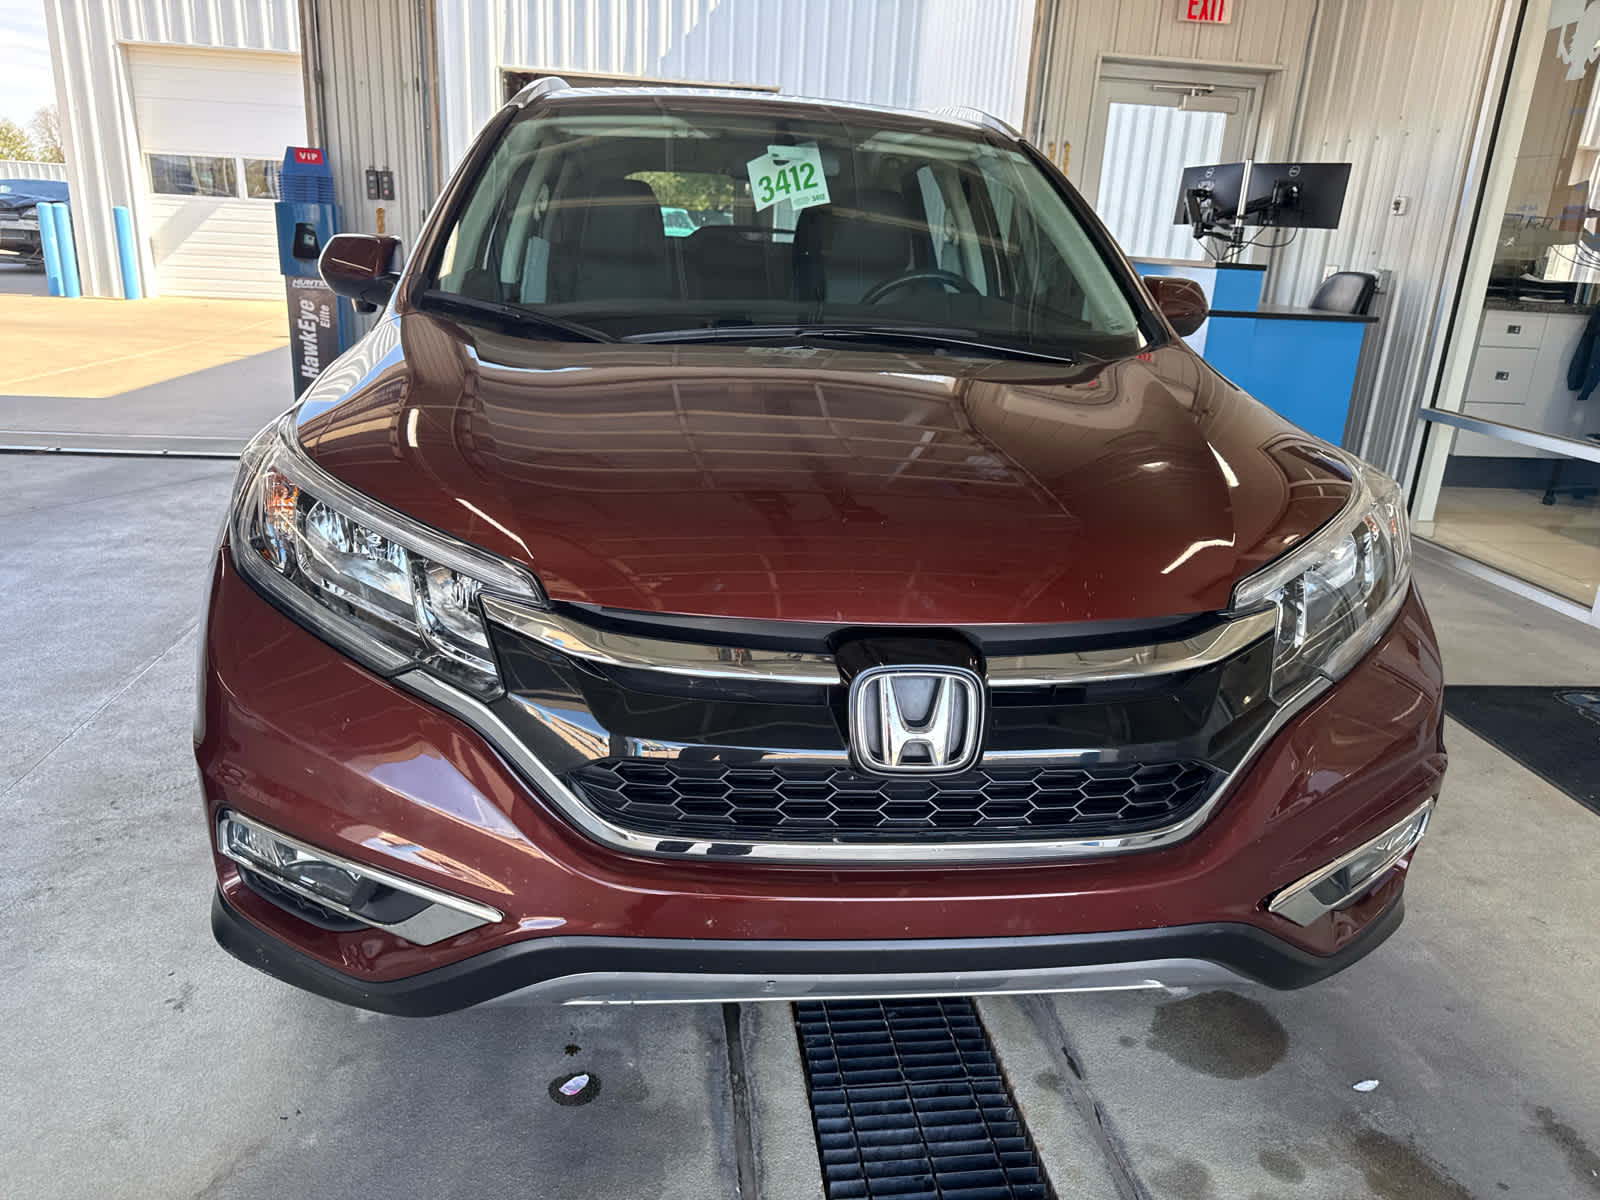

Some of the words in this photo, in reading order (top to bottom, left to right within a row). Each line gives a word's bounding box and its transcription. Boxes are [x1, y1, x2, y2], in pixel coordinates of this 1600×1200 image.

[299, 151, 318, 161] VIP
[758, 162, 818, 203] 3412
[320, 304, 331, 328] Elite
[298, 299, 320, 378] HawkEye
